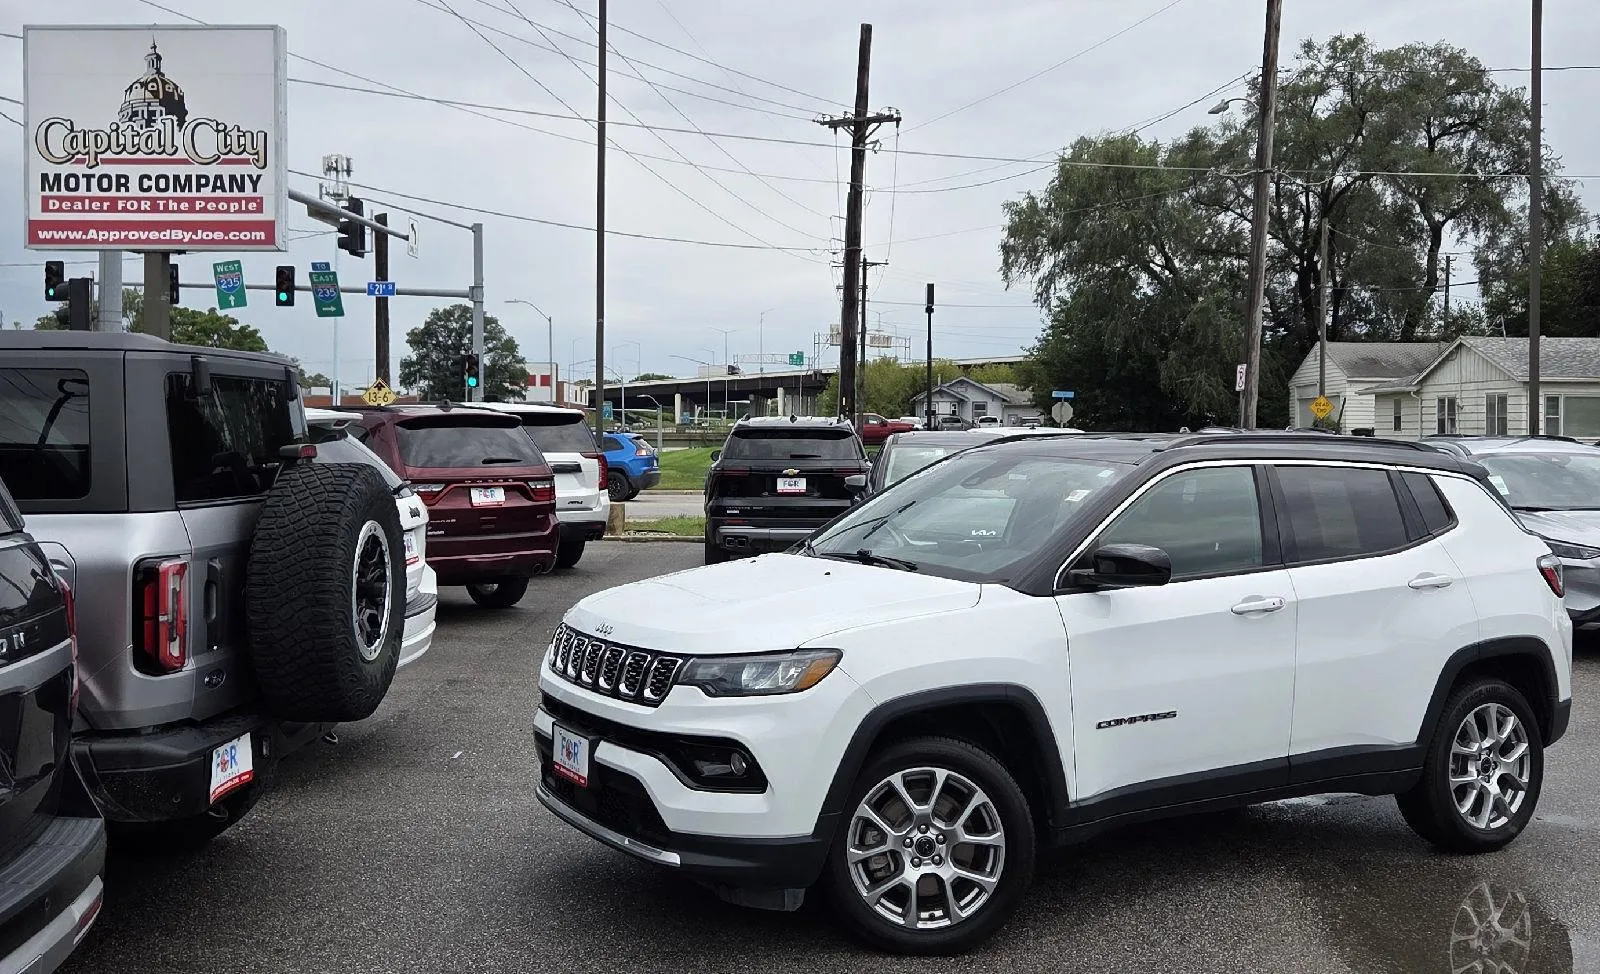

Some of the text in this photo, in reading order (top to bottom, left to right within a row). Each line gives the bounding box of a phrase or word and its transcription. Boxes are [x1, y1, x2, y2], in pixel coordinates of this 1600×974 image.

[35, 117, 267, 169] Capital City
[40, 172, 262, 193] MOTOR COMPANY
[48, 199, 258, 212] Dealer FOR The People
[38, 228, 266, 243] www.ApprovedByJoe.com
[216, 263, 239, 273] WEST
[220, 277, 240, 289] 235
[312, 273, 334, 282] EAST
[317, 288, 337, 297] 235
[1096, 710, 1178, 730] COMPASS
